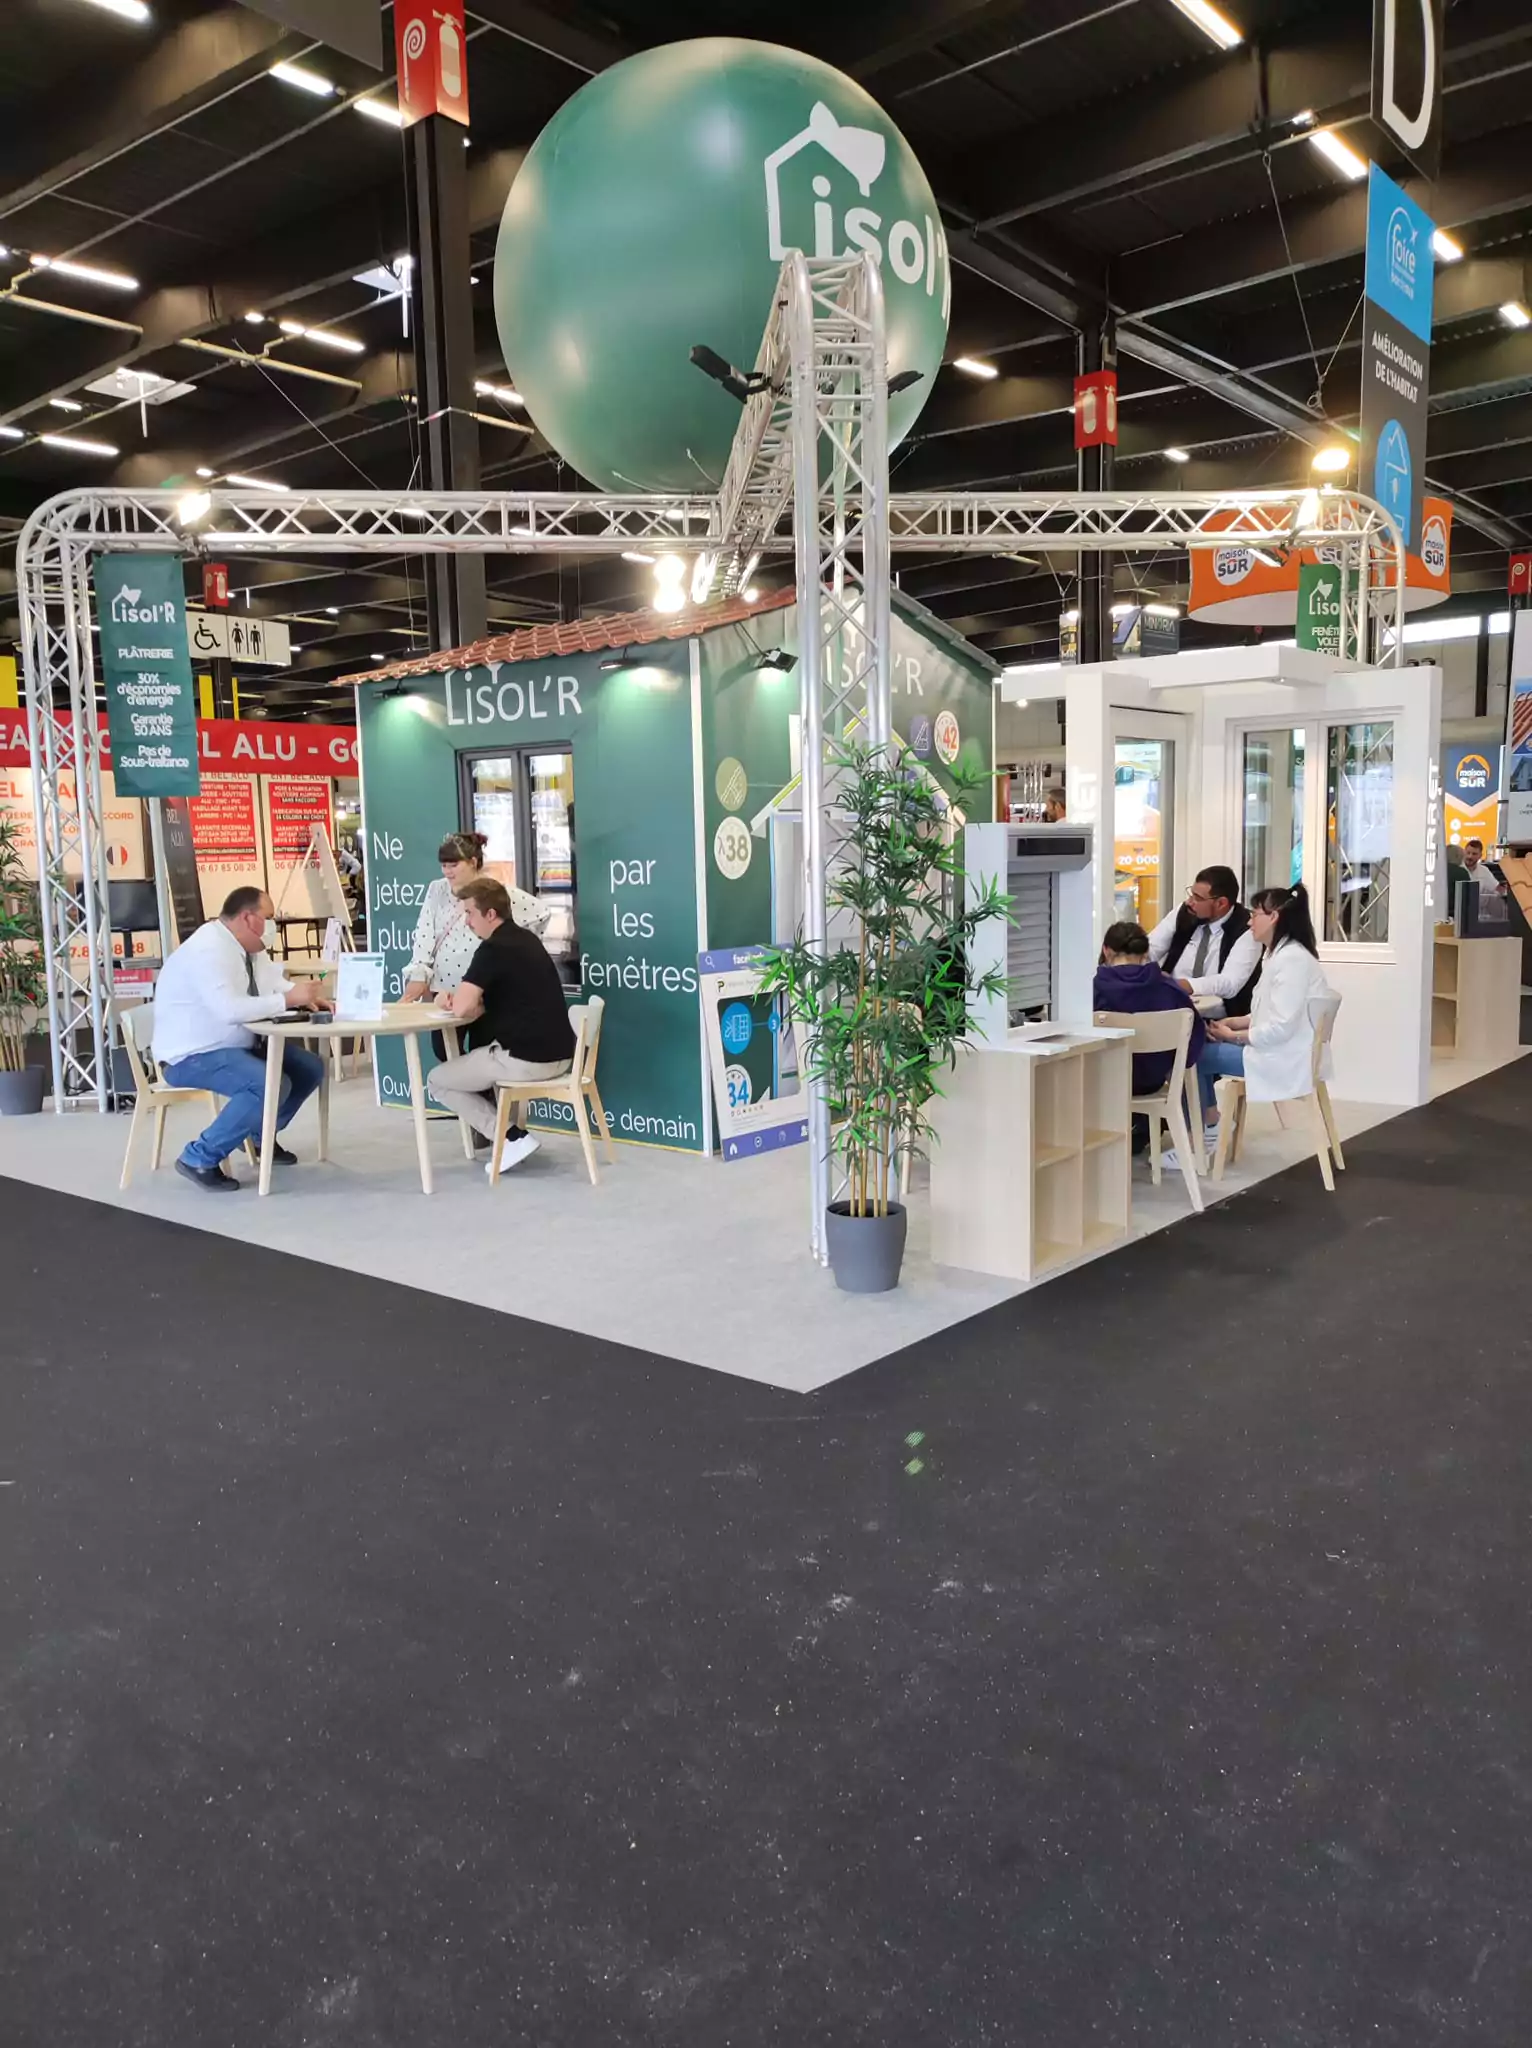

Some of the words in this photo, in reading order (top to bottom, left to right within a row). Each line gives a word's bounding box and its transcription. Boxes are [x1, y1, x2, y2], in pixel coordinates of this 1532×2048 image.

[1371, 330, 1423, 381] AMÉLIORATION
[1375, 359, 1386, 383] DE
[118, 645, 174, 659] PLÂTRERIE
[117, 683, 181, 696] d'économies
[138, 672, 160, 684] 30%
[127, 695, 173, 708] d'énergie
[131, 712, 173, 726] Garantie
[134, 725, 147, 736] 50
[149, 724, 172, 736] ANS
[138, 745, 156, 756] Pas
[158, 744, 171, 757] de
[232, 732, 296, 761] ALU
[373, 831, 403, 860] Ne
[610, 858, 656, 894] par
[374, 876, 425, 911] jetez
[613, 903, 654, 938] les
[580, 952, 697, 993] fenêtres
[620, 1108, 697, 1142] demain
